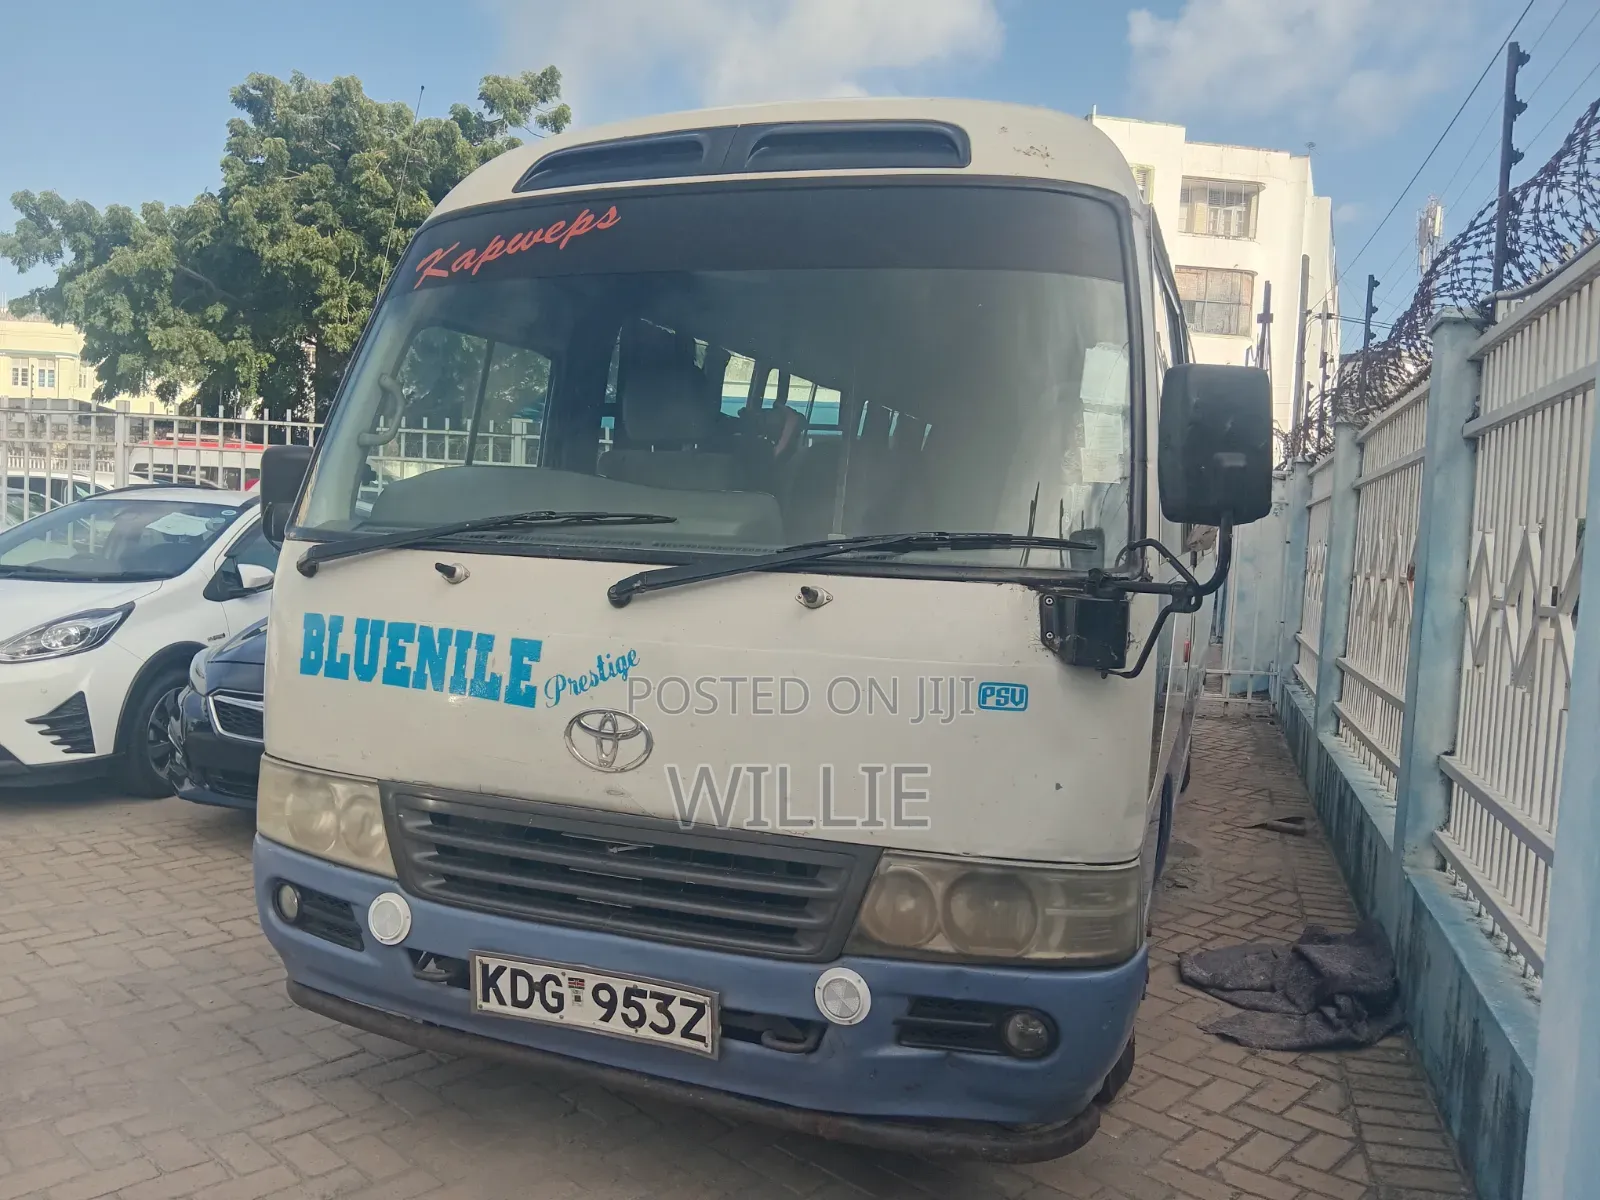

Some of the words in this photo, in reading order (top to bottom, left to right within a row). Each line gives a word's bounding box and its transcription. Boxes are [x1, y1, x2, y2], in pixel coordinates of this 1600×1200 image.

[413, 205, 622, 290] Kapweps
[544, 647, 641, 708] Prestige
[980, 685, 1026, 708] PSV
[481, 963, 565, 1014] KDG
[591, 982, 707, 1043] 953Z
